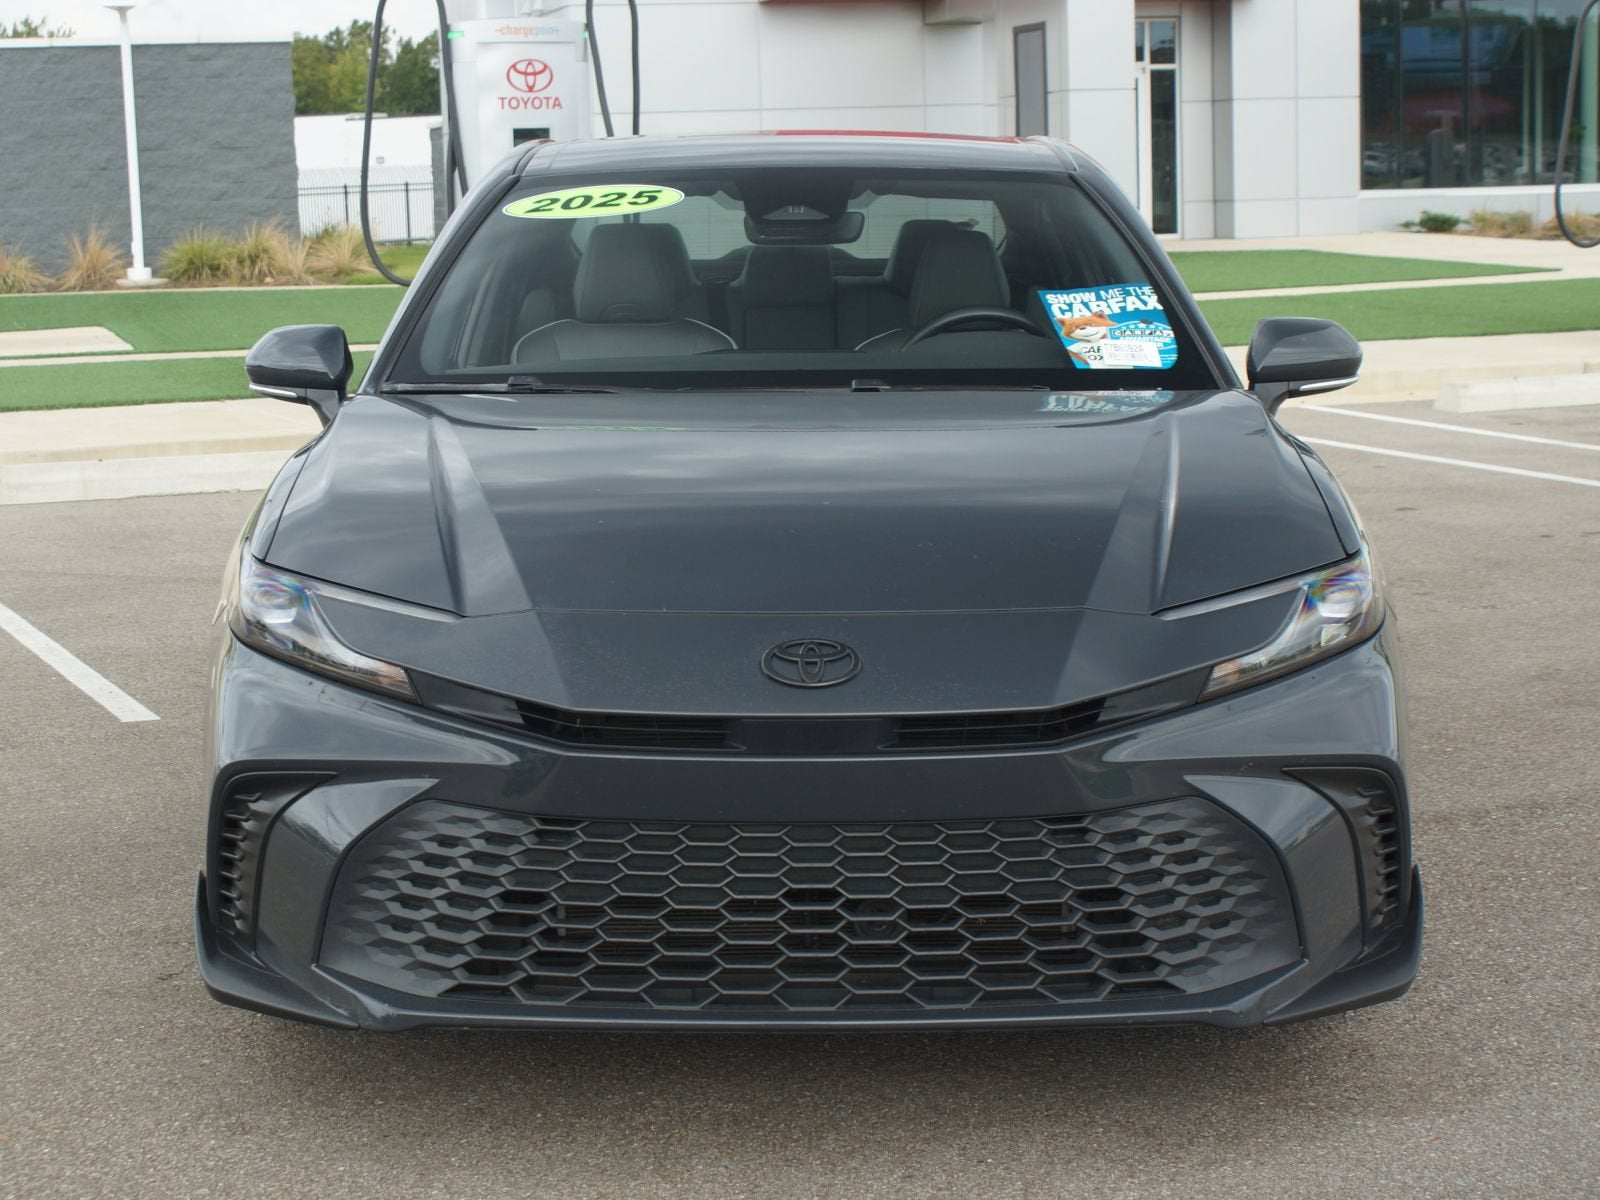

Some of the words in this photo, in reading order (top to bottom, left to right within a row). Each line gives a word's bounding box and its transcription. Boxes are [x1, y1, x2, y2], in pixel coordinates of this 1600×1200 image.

[498, 96, 562, 110] TOYOTA
[524, 189, 663, 214] 2025
[1045, 292, 1096, 304] SHOW
[1101, 288, 1126, 300] ME
[1126, 285, 1156, 297] THE
[1051, 295, 1164, 319] CARFAX
[1113, 328, 1174, 338] CARFAX
